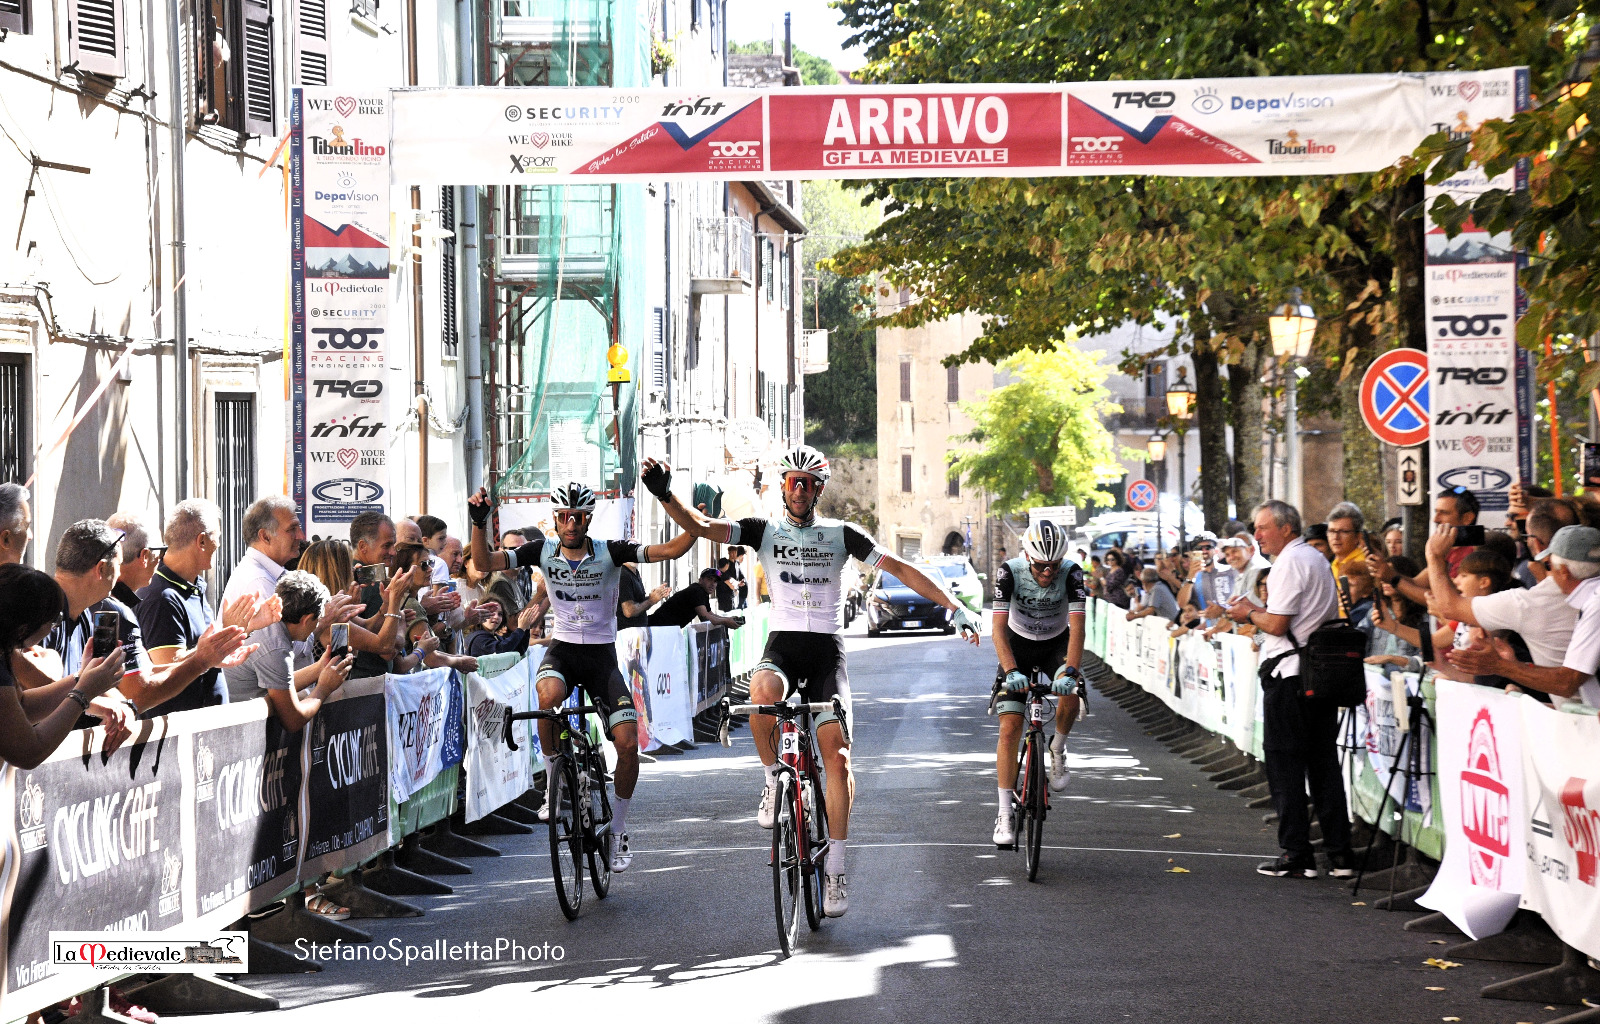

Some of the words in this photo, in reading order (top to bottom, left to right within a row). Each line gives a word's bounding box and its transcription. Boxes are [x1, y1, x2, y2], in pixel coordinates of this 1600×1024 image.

[1430, 84, 1458, 97] WE
[307, 98, 333, 112] WE
[359, 98, 384, 106] YOUR
[1230, 92, 1334, 113] DepaVision
[359, 106, 384, 115] BIKE
[526, 106, 624, 120] SECURITY
[823, 96, 1009, 146] ARRIVO
[508, 134, 530, 145] WE
[826, 152, 851, 165] GF
[858, 151, 884, 164] LA
[890, 150, 1004, 164] MEDIEVALE
[315, 190, 379, 202] DepaVision
[311, 283, 322, 293] La
[324, 282, 383, 296] Medievale
[322, 309, 377, 317] SECURITY
[1436, 439, 1462, 451] WE
[310, 452, 336, 463] WE
[360, 457, 386, 466] BIKE
[328, 728, 362, 790] CYCLING
[216, 755, 262, 830] CYCLING
[260, 747, 288, 812] CAFE
[54, 791, 121, 885] CYCLING
[120, 780, 162, 860] CAFE
[247, 855, 276, 889] CIAMPINO
